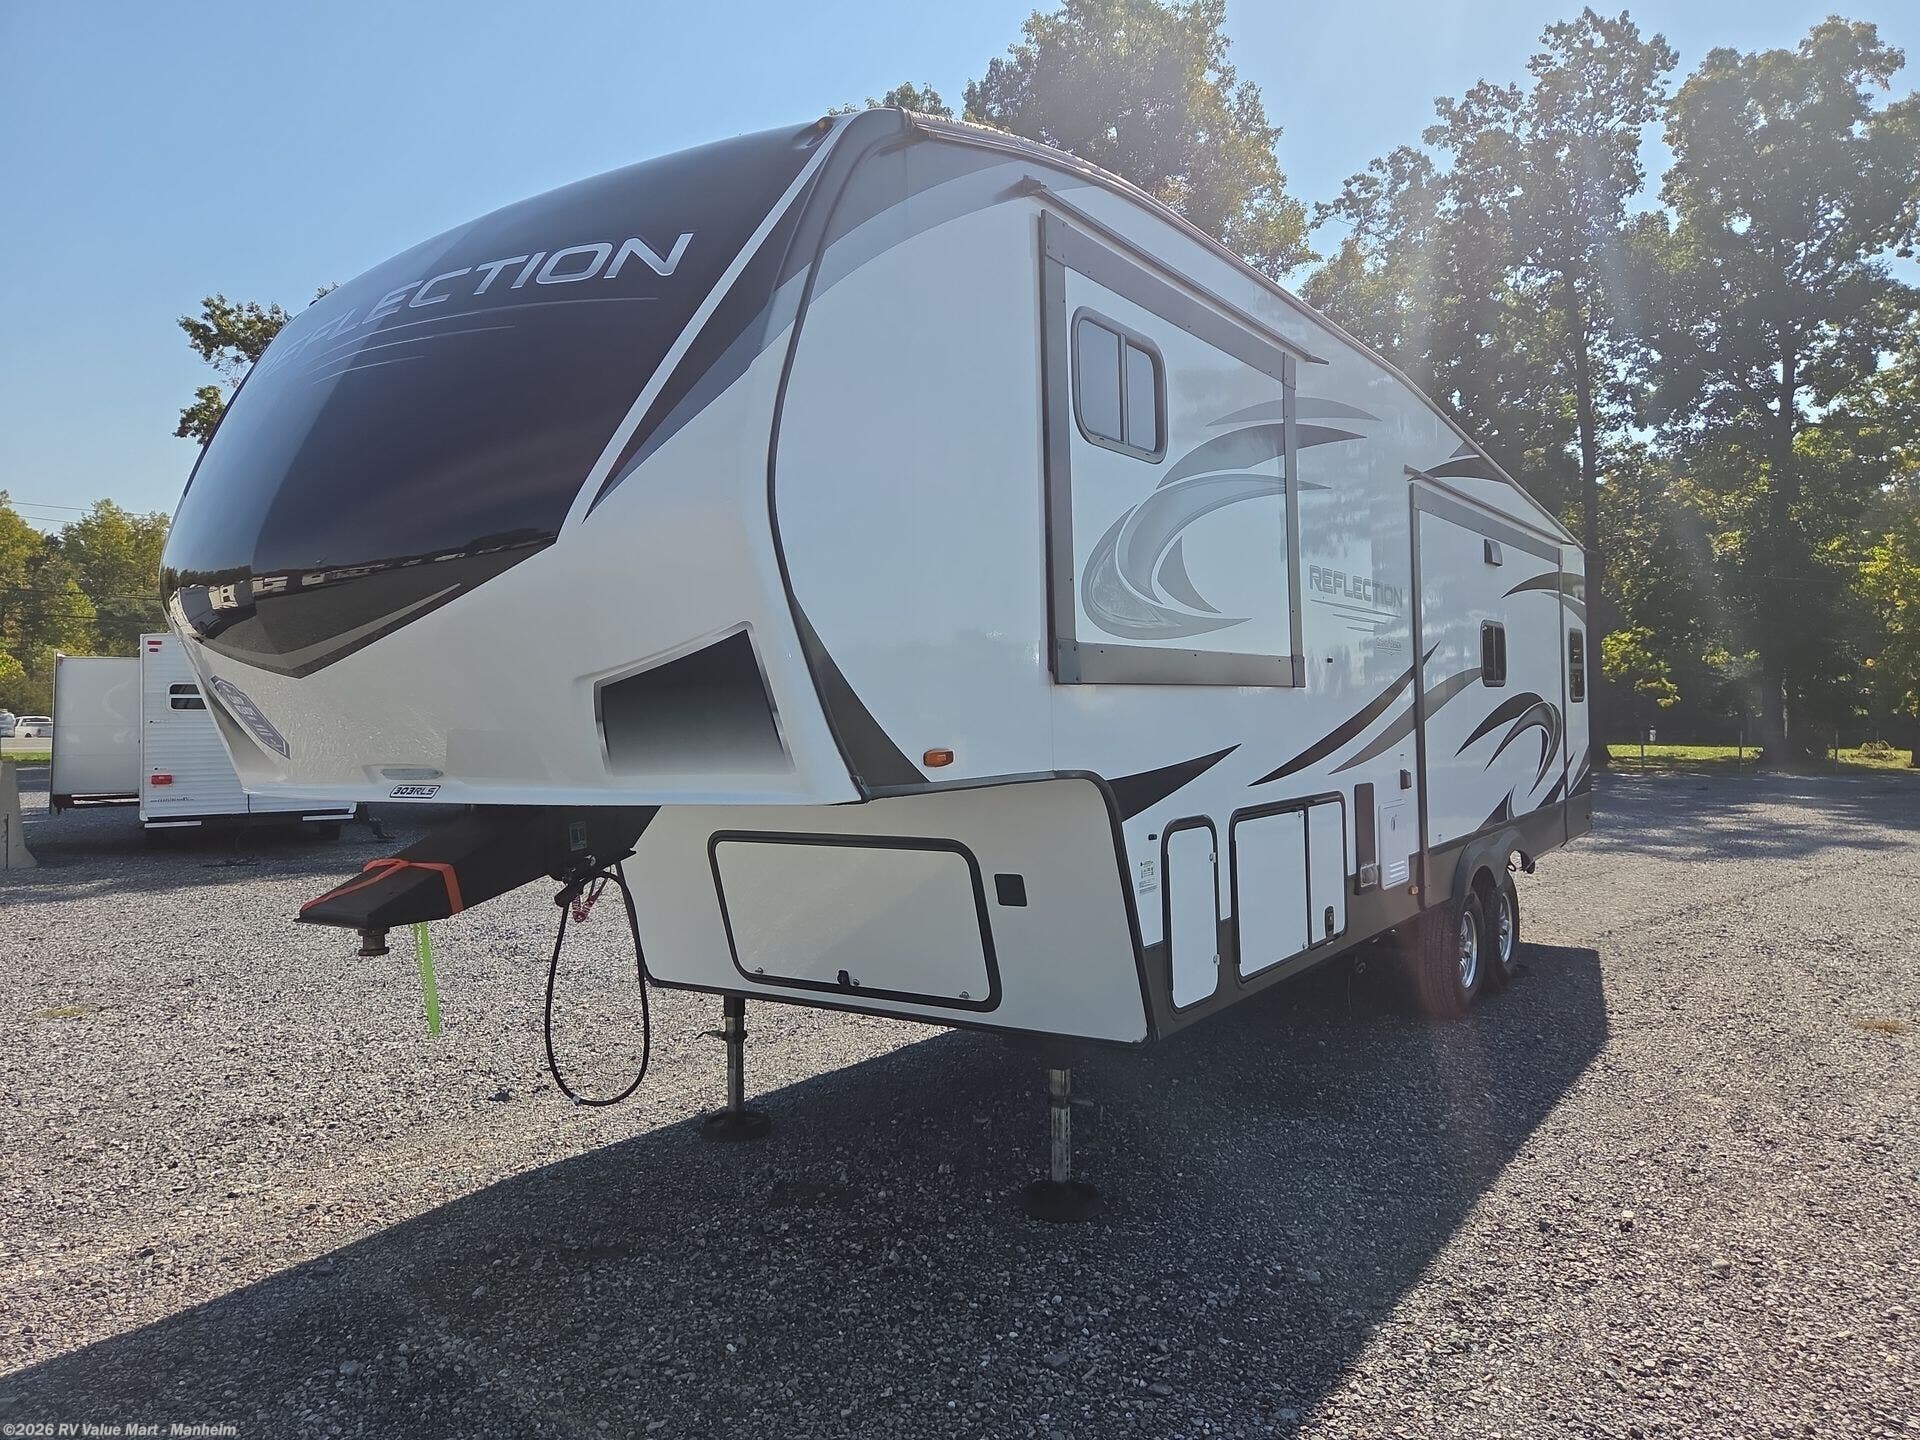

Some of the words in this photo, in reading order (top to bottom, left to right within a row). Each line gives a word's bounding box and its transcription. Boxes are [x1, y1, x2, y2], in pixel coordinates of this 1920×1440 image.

[256, 232, 694, 377] FLECTION
[1309, 564, 1402, 608] REFLECTION
[393, 786, 437, 796] 303RLS
